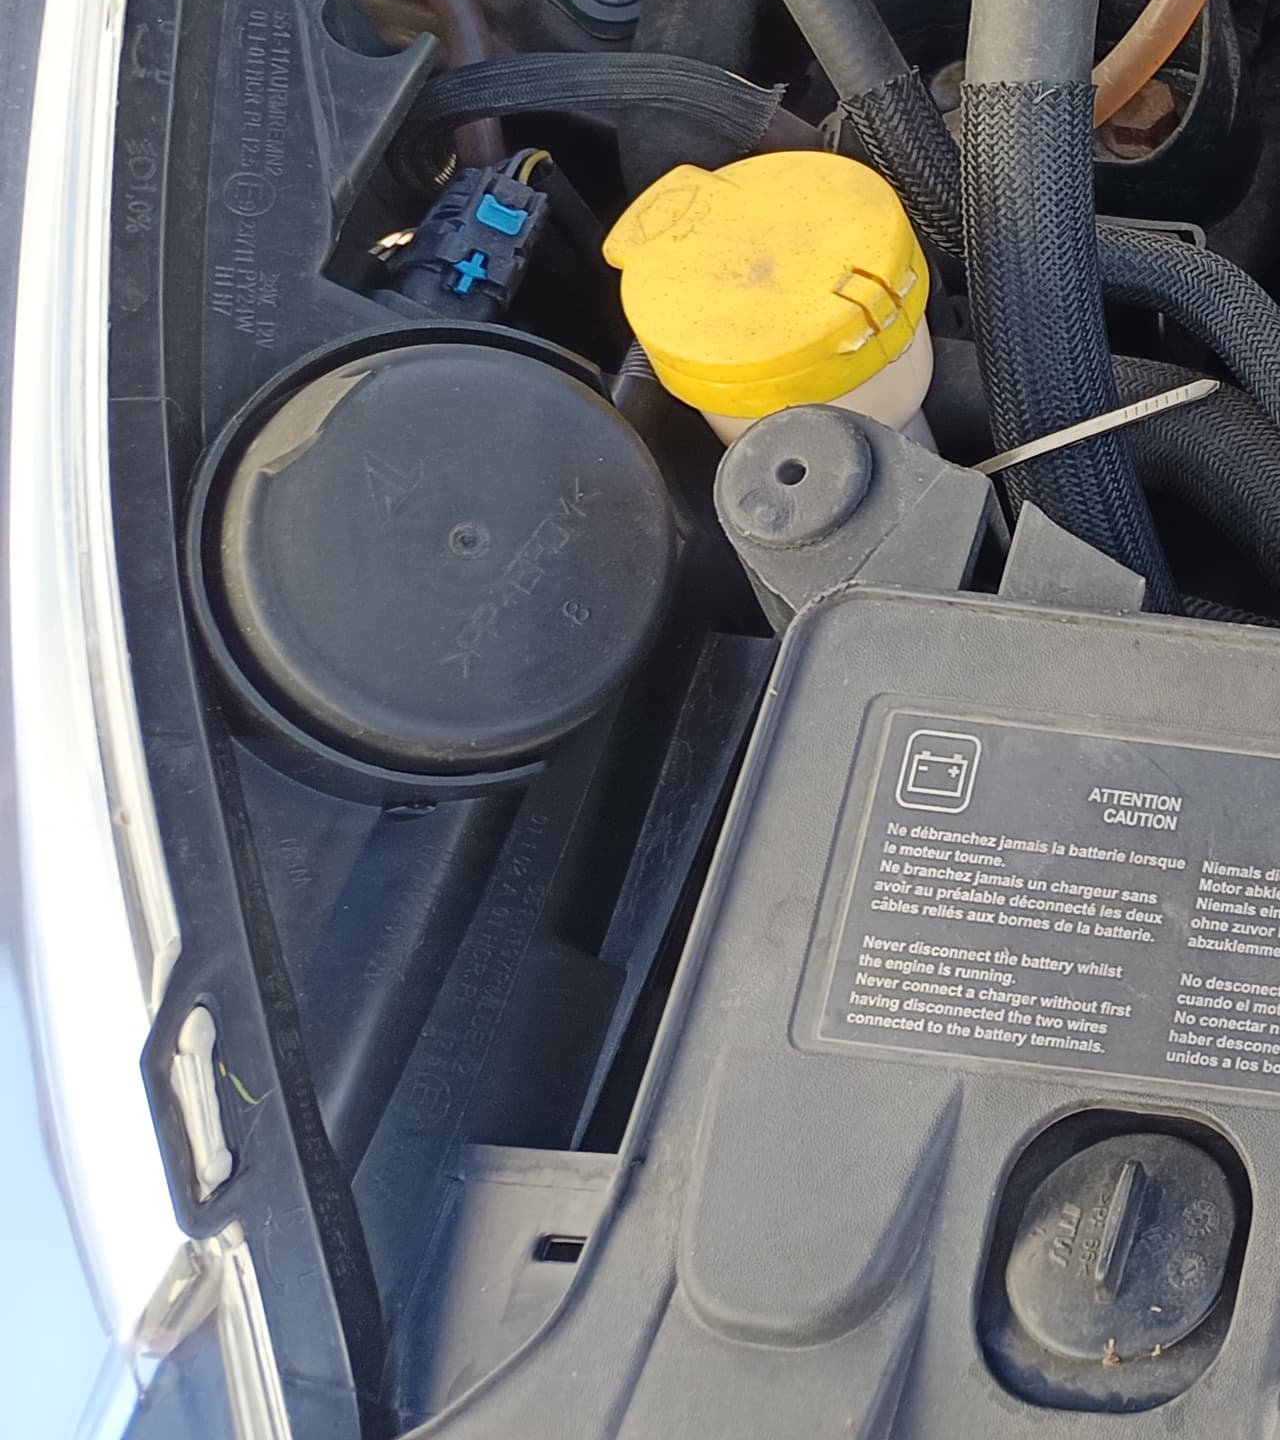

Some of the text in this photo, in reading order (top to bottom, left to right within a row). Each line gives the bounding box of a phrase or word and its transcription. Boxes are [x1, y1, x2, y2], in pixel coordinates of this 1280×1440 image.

[1087, 786, 1183, 813] ATTENTION
[1102, 807, 1179, 832] CAUTION
[882, 839, 1007, 869] le moteur tourne.
[886, 821, 1187, 871] Ne débranchez jamais la batterie lorsque
[878, 858, 1159, 905] Ne branchez jamais un chargeur sans
[1197, 877, 1244, 896] Motor
[1200, 859, 1263, 881] Niemals
[869, 895, 1156, 944] câbles reliés aux bornes de la batterie.
[872, 879, 1164, 926] avoir au préalable déconnecté les deux
[1194, 895, 1258, 917] Niemals
[857, 952, 1017, 988] the engine is running.
[861, 934, 1124, 979] Never disconnect the battery whilst
[848, 990, 1109, 1035] having disconnected the two wires
[854, 970, 1133, 1018] Never connect a charger without first
[845, 1012, 1106, 1054] connected to the battery terminals.
